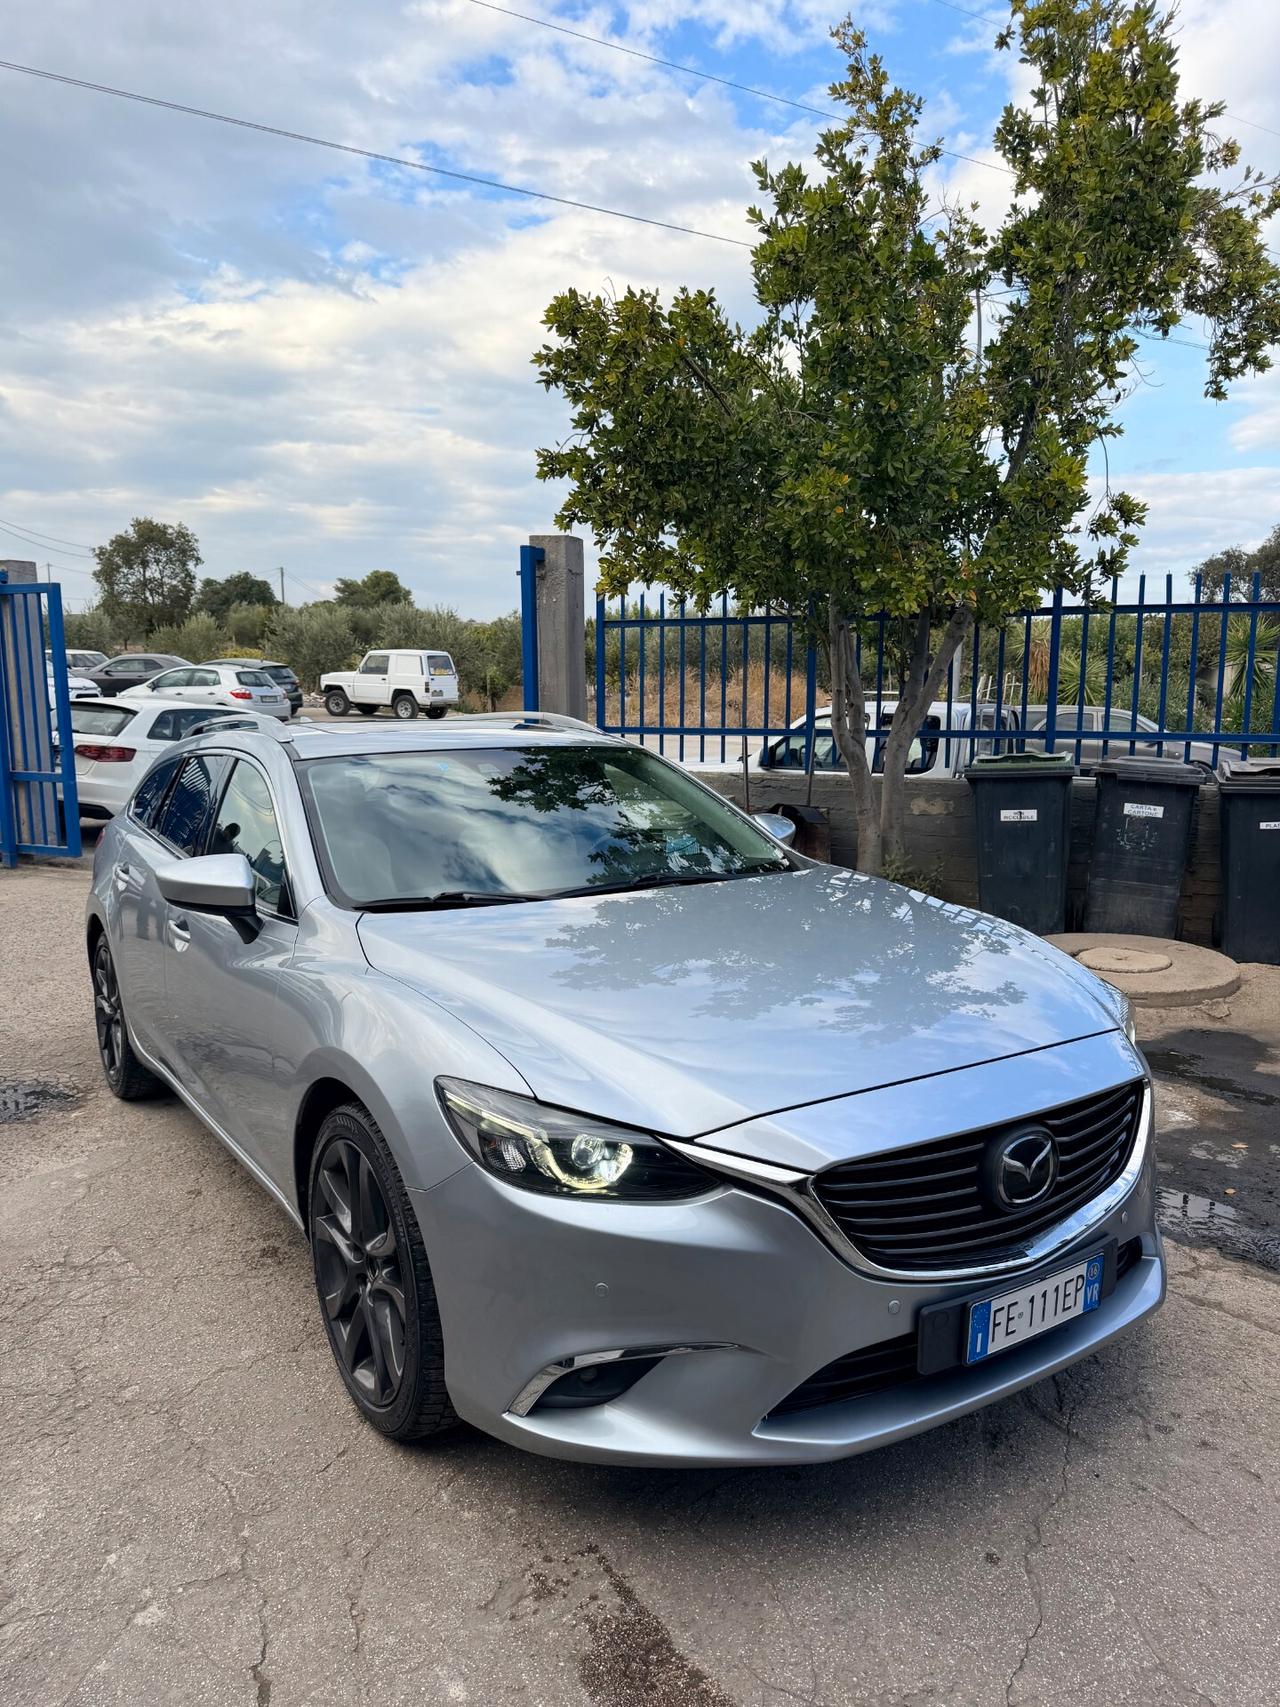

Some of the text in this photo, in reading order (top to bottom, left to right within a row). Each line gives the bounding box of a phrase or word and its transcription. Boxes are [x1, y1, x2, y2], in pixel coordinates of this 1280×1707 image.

[1127, 809, 1159, 817] CARTONE
[1087, 1283, 1099, 1304] VR
[991, 1274, 1085, 1343] FE 111EP
[976, 1332, 982, 1353] I
